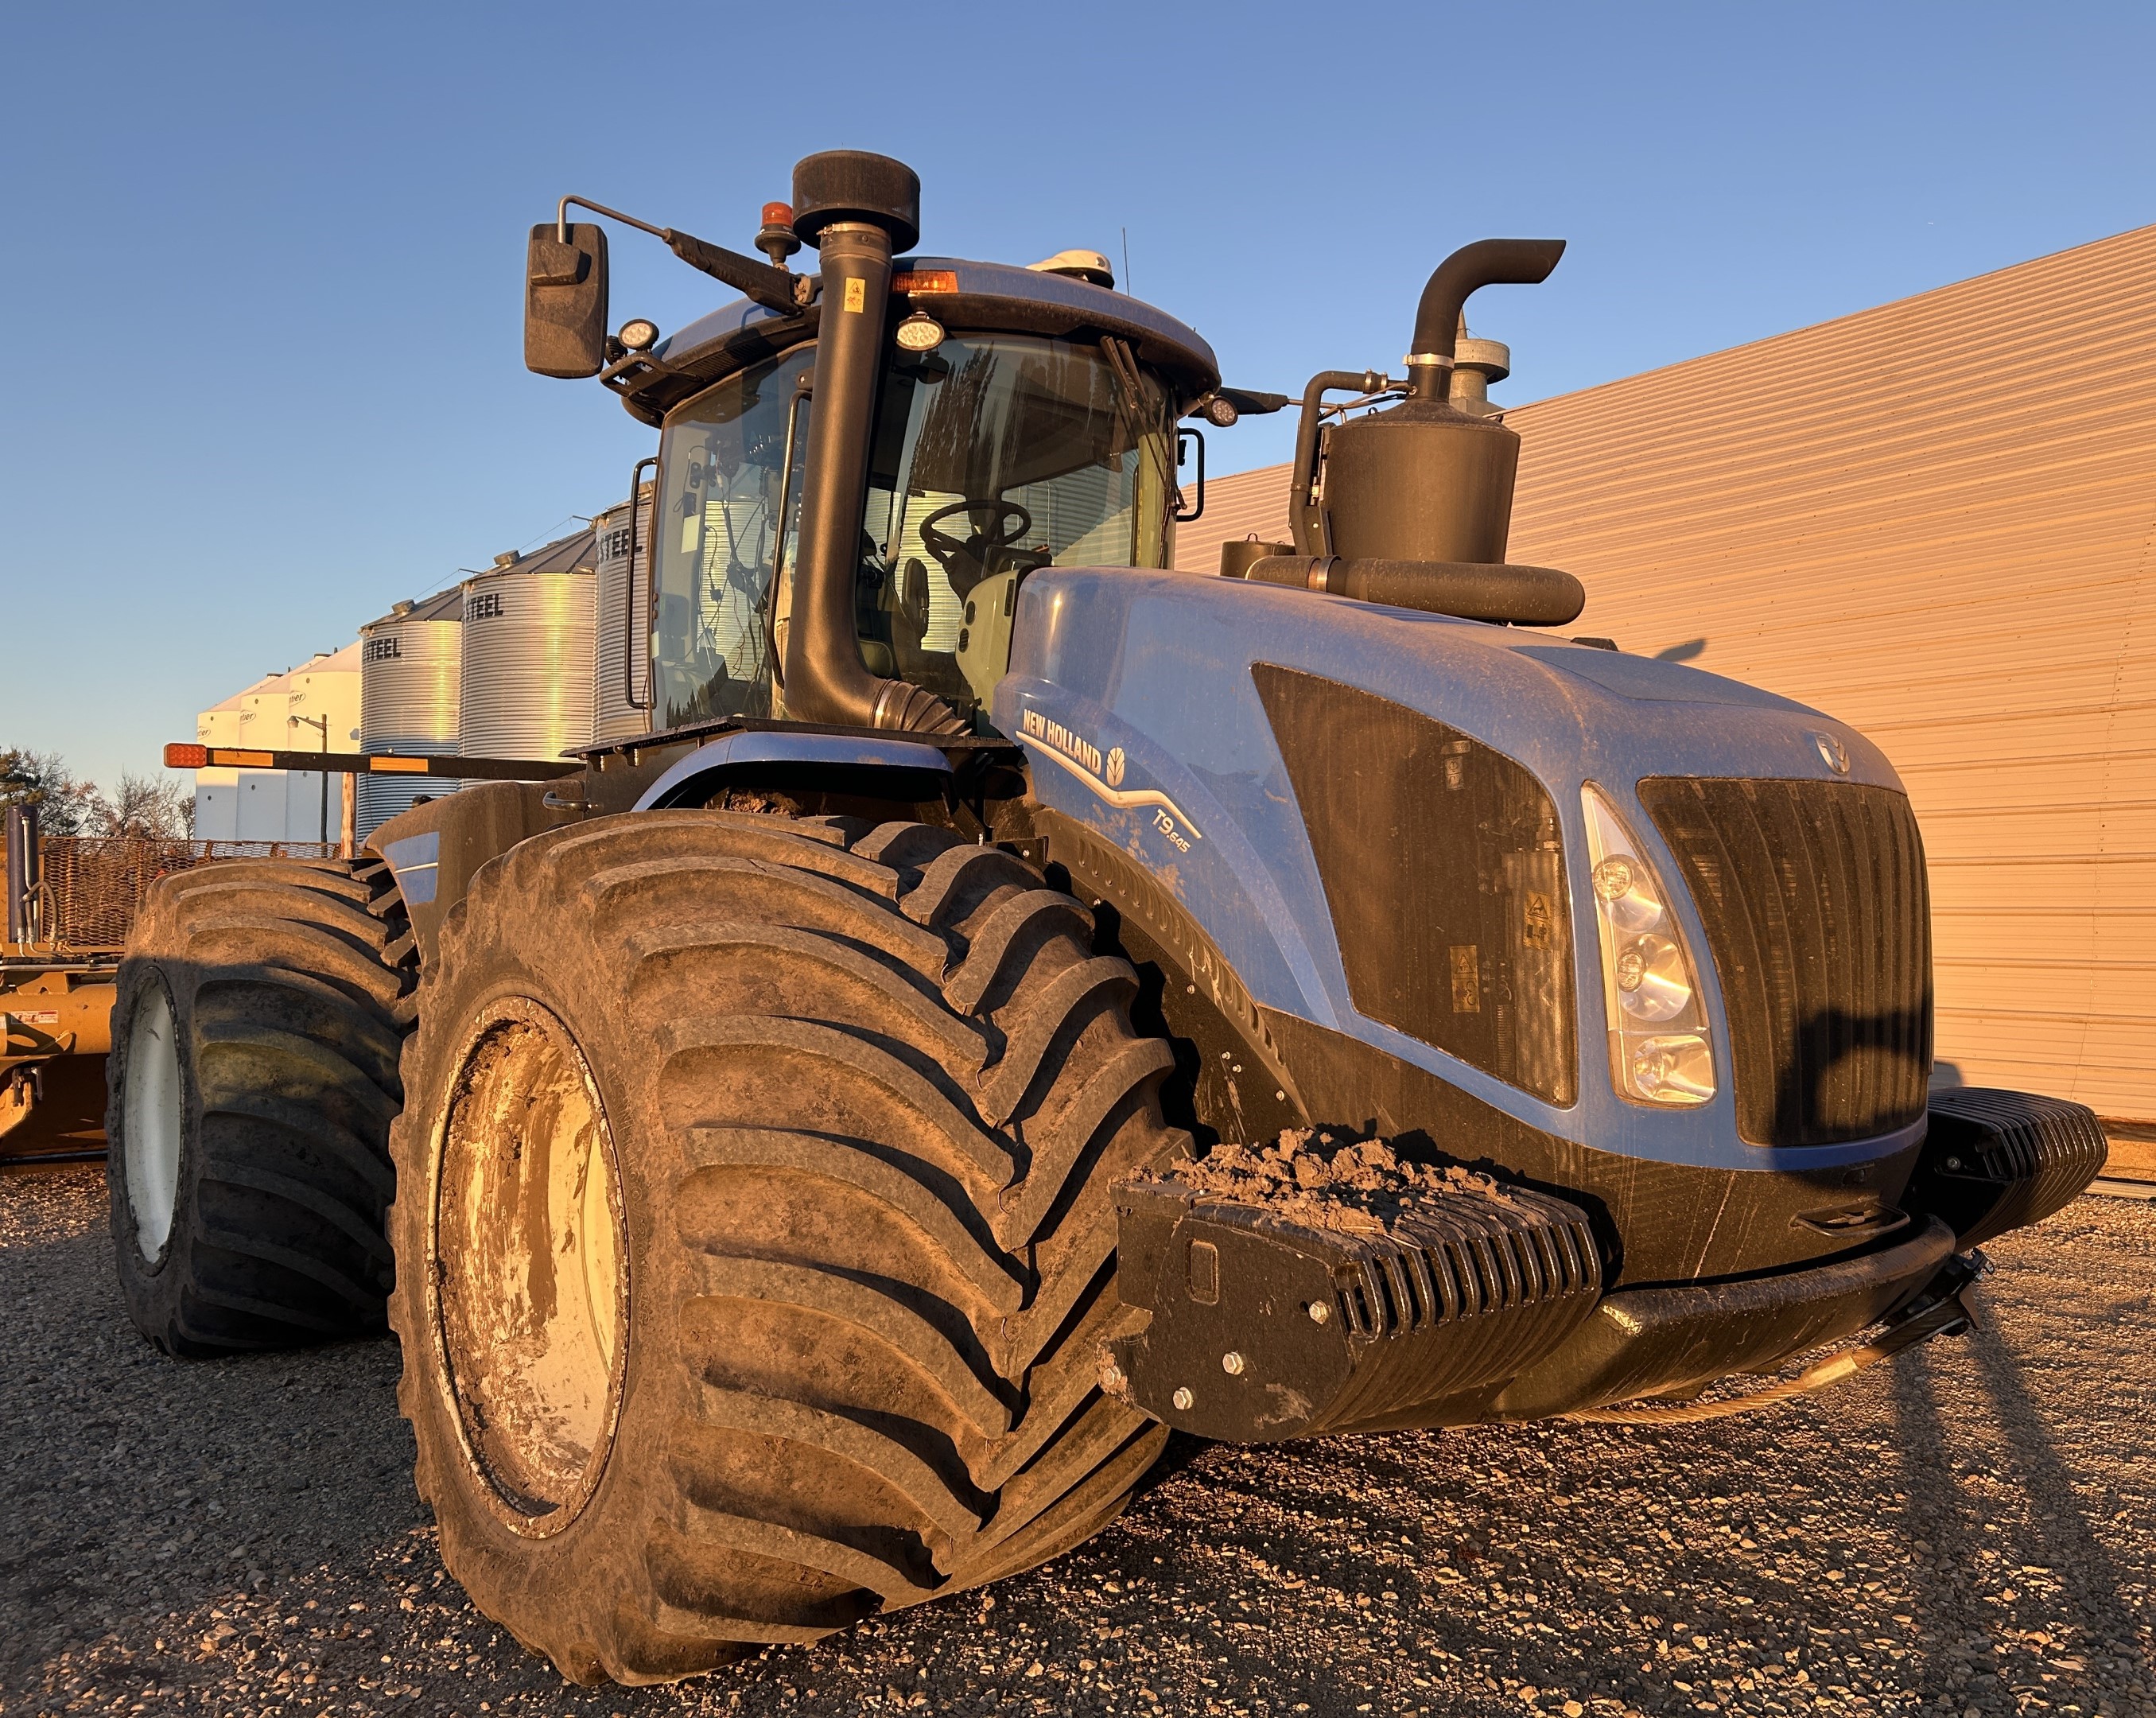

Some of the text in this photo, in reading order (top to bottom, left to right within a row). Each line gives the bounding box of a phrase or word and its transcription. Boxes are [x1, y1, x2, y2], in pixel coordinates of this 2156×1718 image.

[1023, 708, 1101, 775] NEW HOLLAND
[1152, 808, 1191, 853] T9.645
